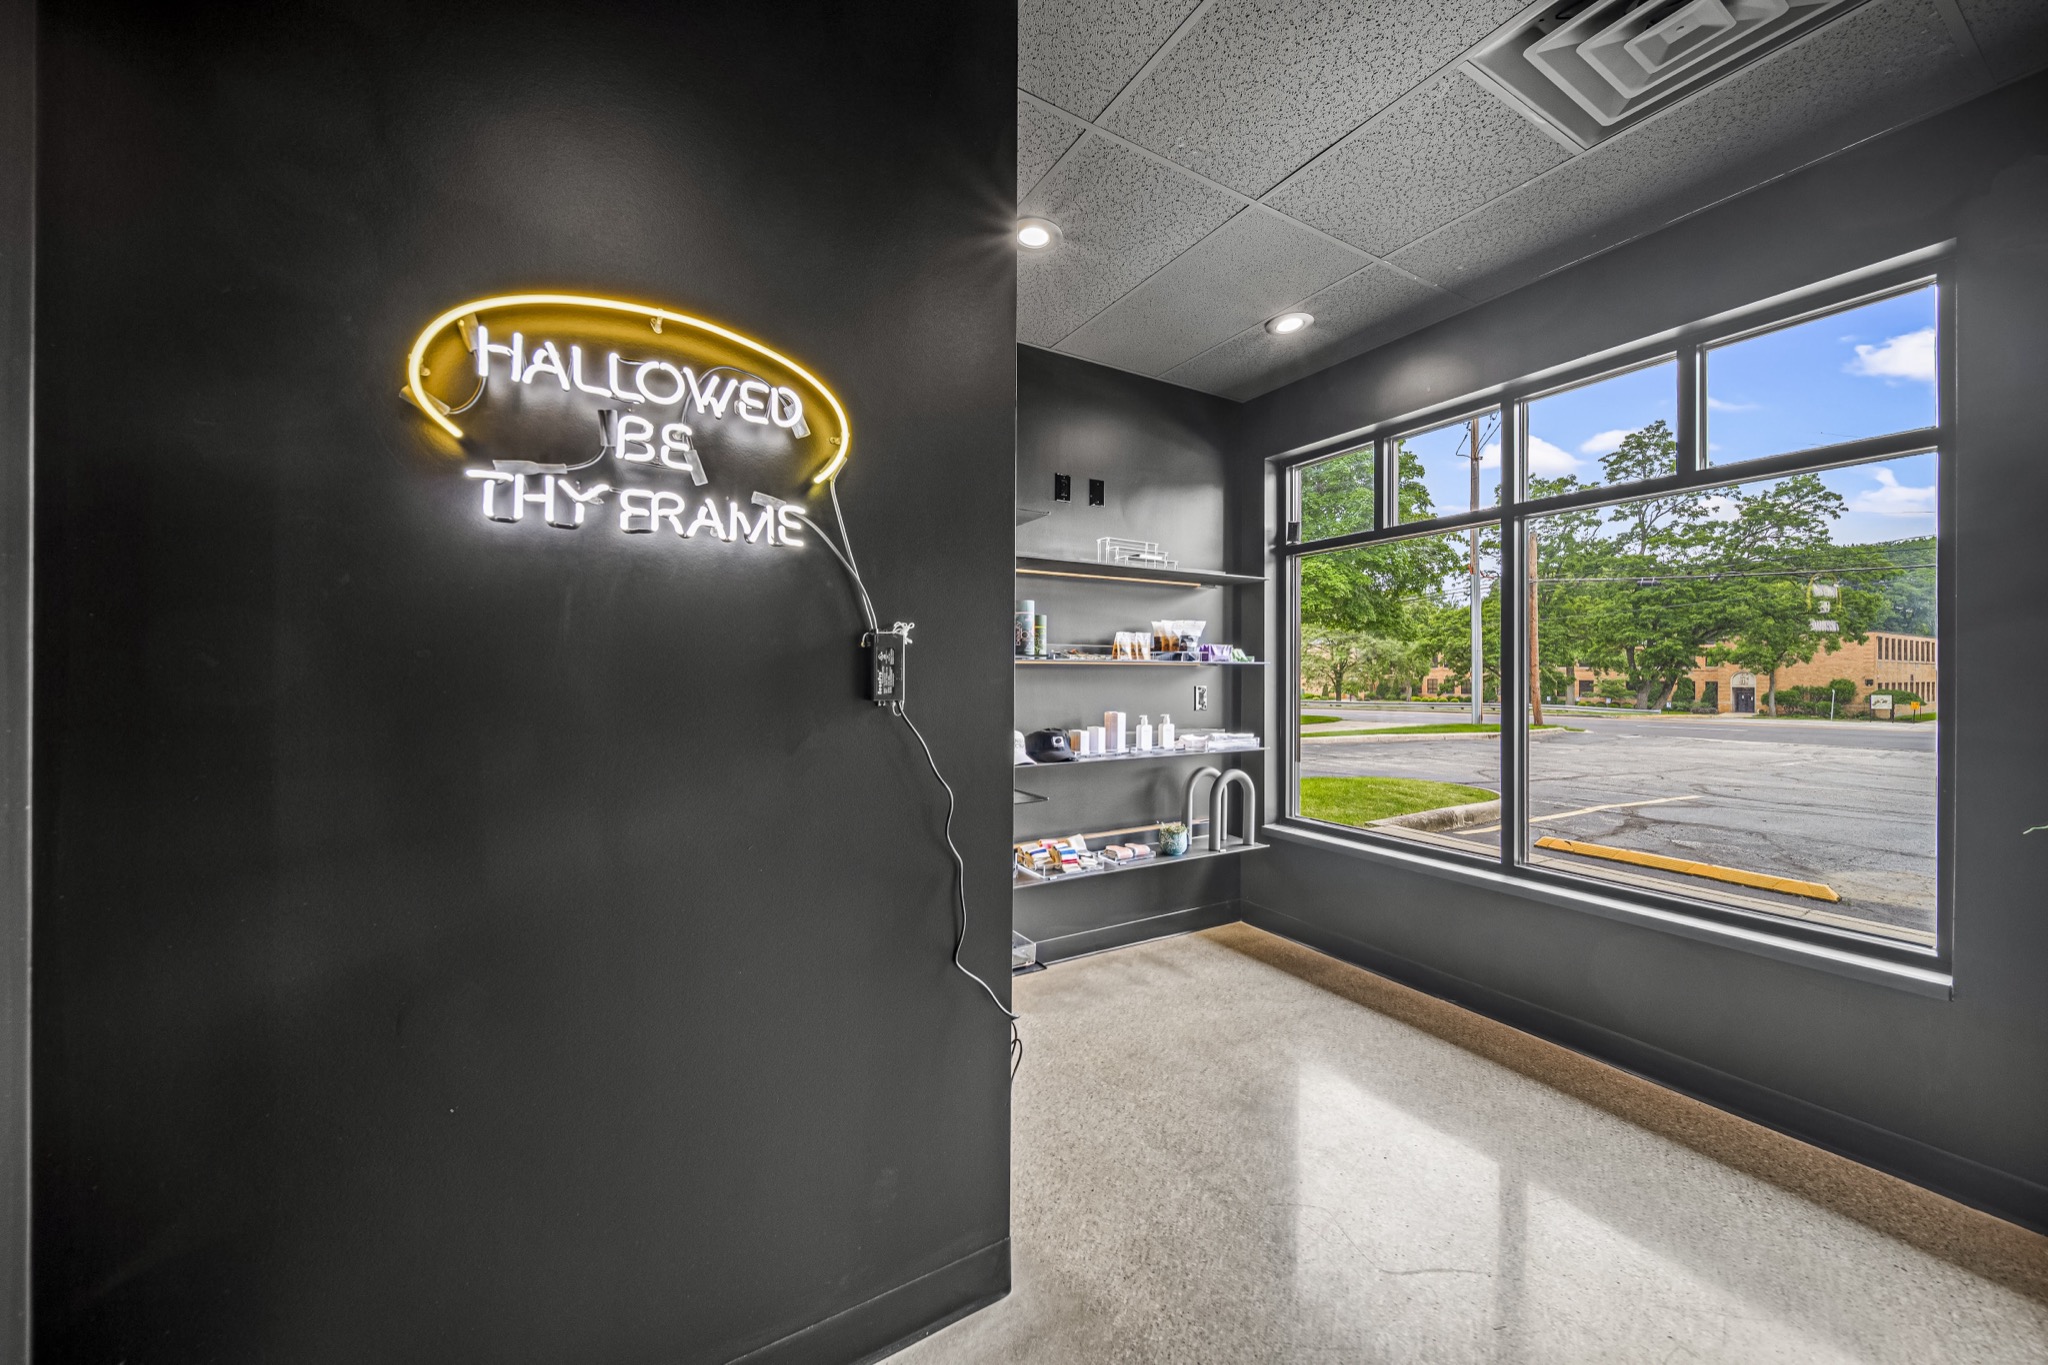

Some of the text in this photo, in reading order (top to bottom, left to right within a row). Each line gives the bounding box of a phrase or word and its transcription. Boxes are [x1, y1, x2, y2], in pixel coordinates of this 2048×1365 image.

[477, 325, 803, 428] HALLOWED
[616, 415, 693, 471] BE
[465, 469, 807, 546] THY FRAME
